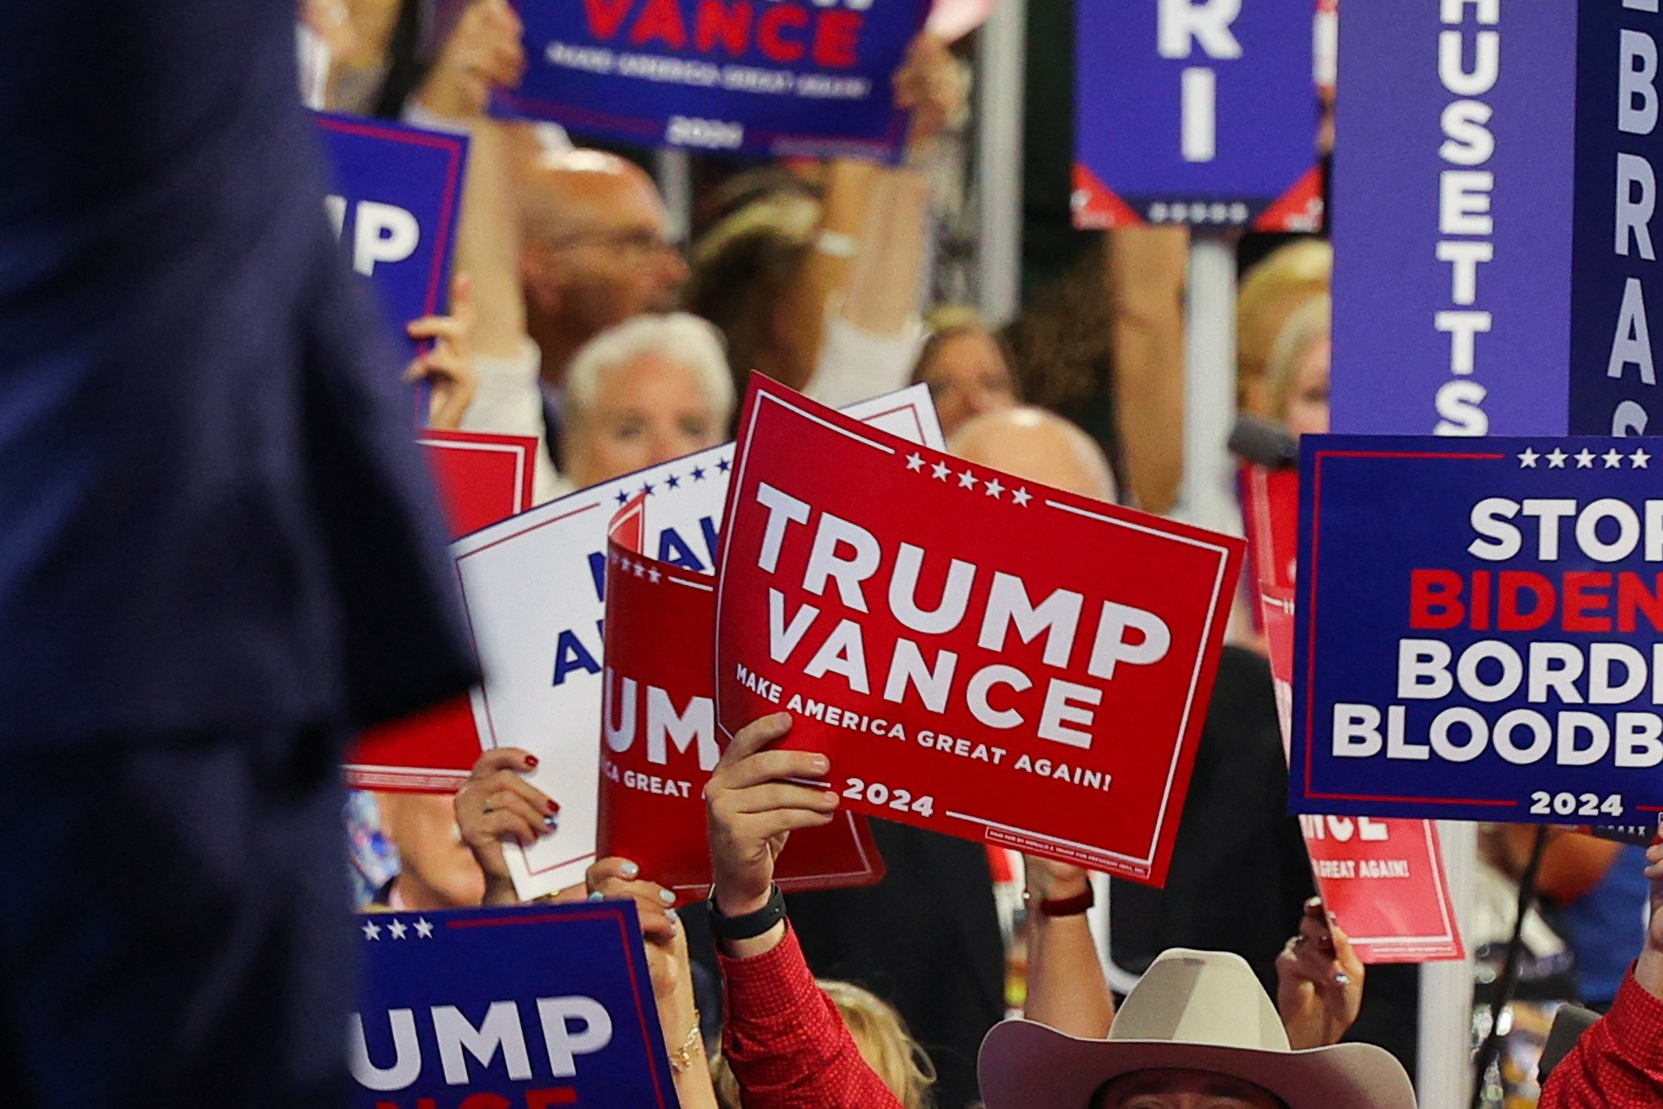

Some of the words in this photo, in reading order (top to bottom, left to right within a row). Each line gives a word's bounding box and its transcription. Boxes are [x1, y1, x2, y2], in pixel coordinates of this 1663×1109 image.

[756, 482, 1171, 680] TRUMP
[769, 586, 1103, 750] VANCE
[1397, 639, 1663, 704] BORD
[736, 663, 783, 704] MAKE
[786, 694, 907, 742] AMERICA
[916, 729, 1007, 765] GREAT
[1014, 753, 1113, 791] AGAIN!
[623, 770, 692, 799] GREAT
[842, 777, 935, 818] 2024
[1529, 791, 1624, 817] 2024
[1359, 860, 1410, 878] AGAIN!
[348, 995, 612, 1091] UMP
